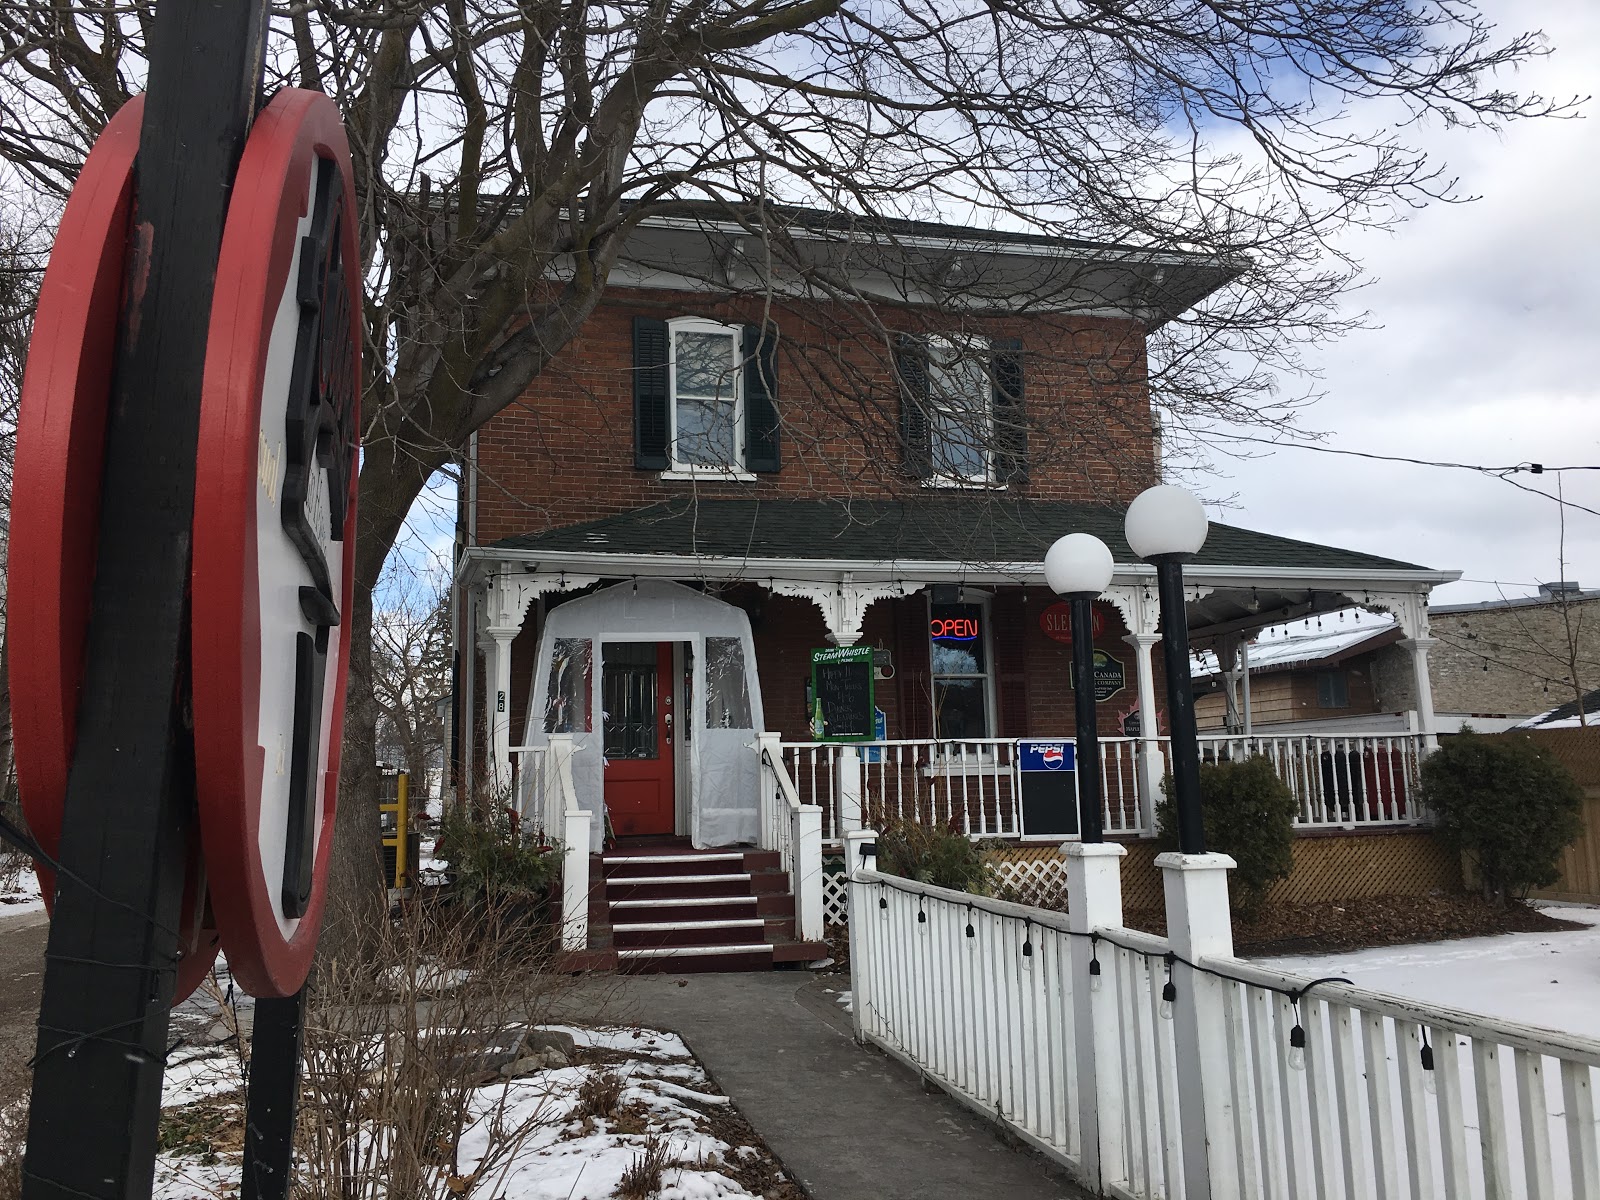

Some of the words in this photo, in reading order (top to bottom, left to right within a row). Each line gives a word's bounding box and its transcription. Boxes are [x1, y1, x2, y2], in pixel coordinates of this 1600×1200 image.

[930, 619, 978, 637] OPEN
[1046, 613, 1100, 632] SLEN
[1029, 743, 1065, 754] PEPSI
